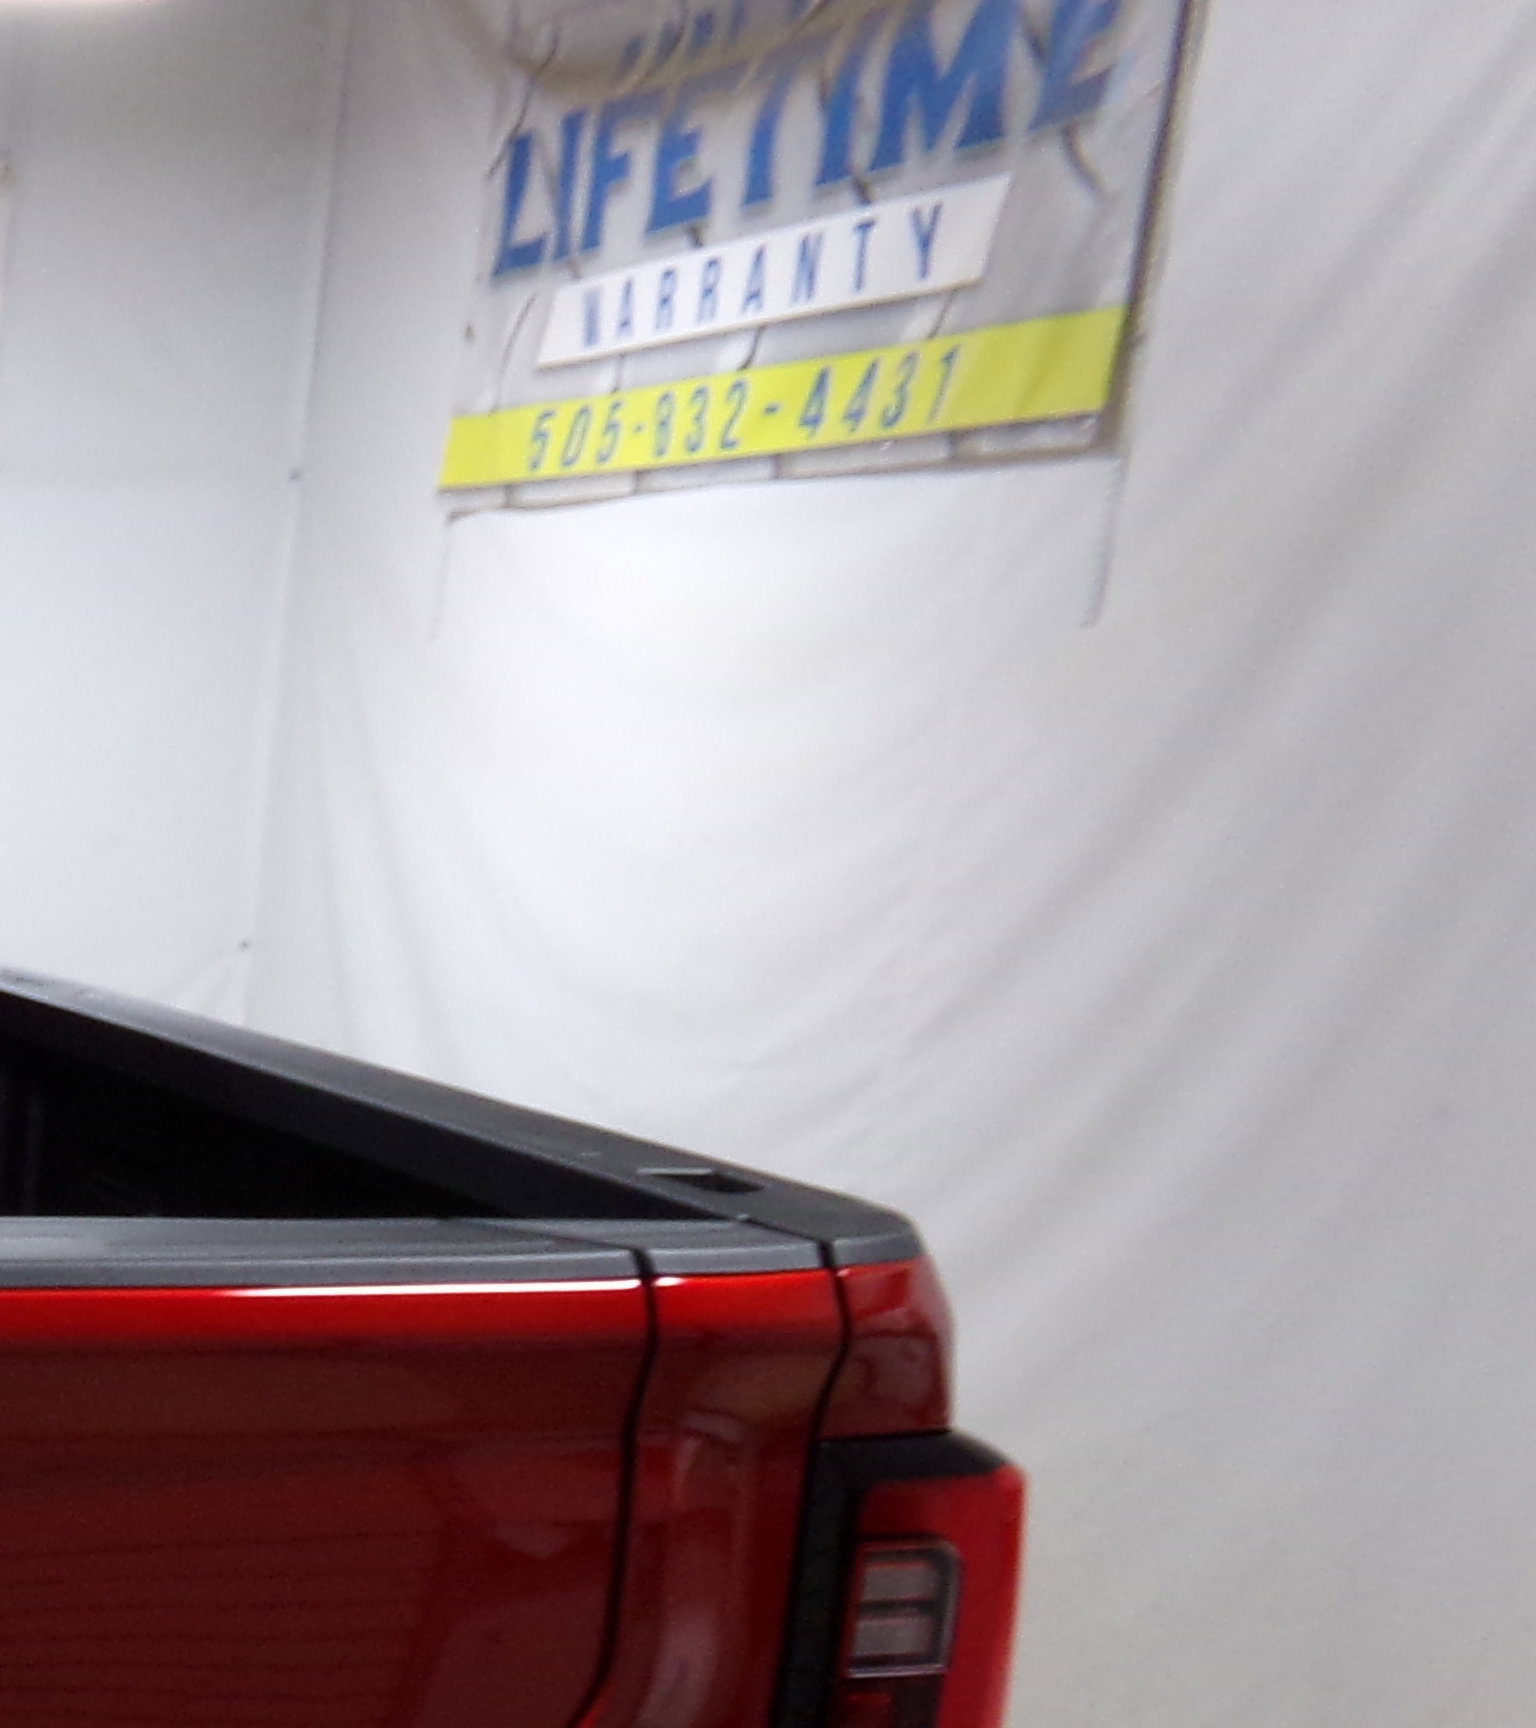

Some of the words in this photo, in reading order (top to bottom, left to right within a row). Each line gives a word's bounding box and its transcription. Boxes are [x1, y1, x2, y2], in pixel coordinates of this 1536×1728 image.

[492, 0, 1120, 280] LIFETIME
[580, 202, 945, 350] WARRANTY
[527, 344, 962, 471] 505-832-4431
